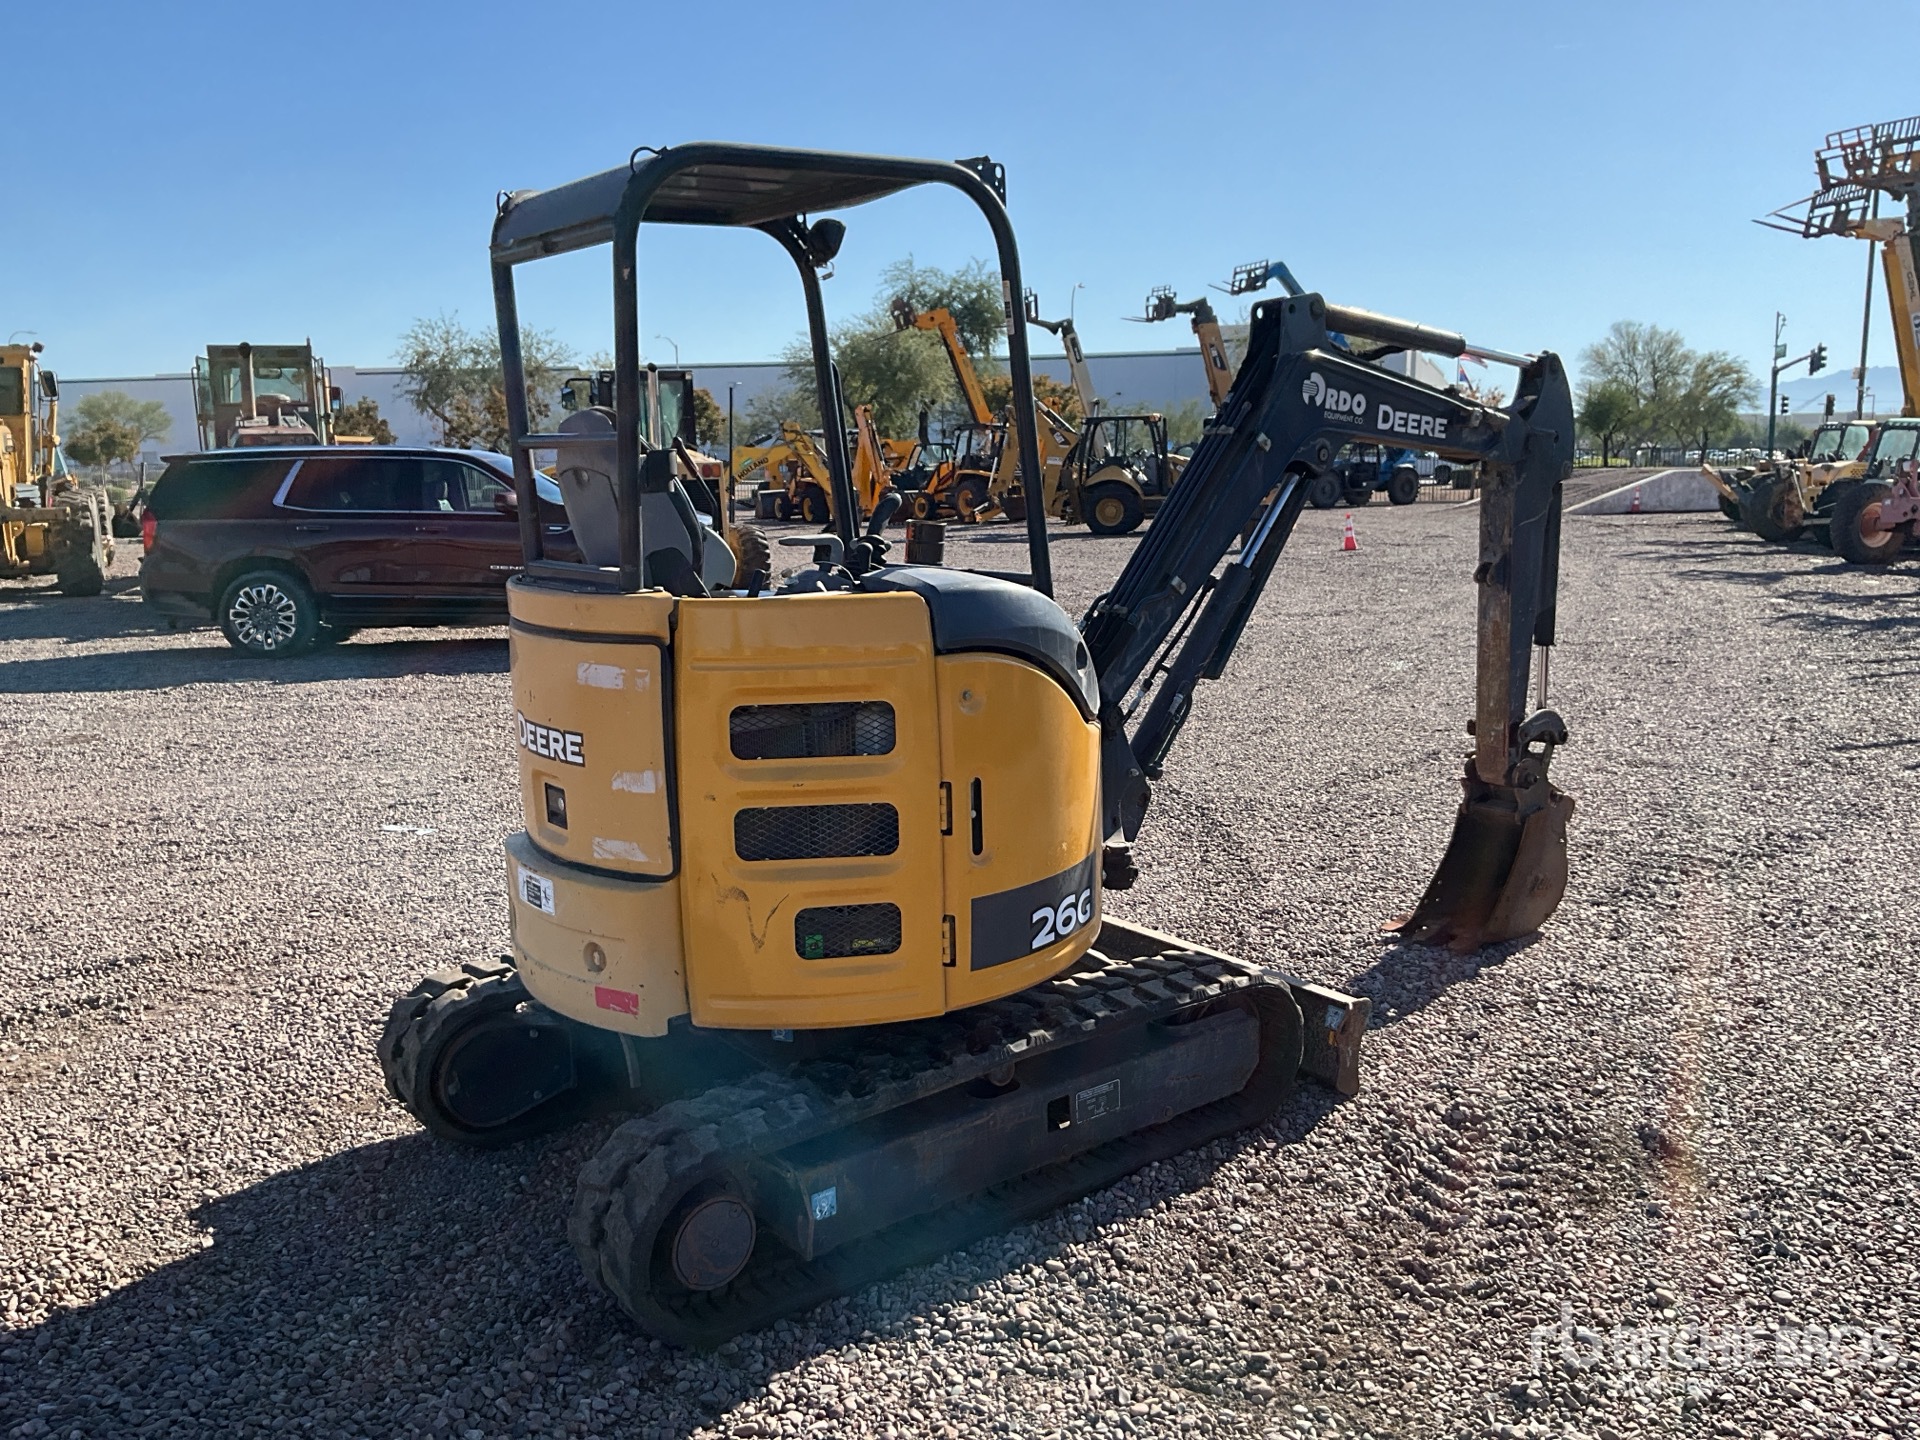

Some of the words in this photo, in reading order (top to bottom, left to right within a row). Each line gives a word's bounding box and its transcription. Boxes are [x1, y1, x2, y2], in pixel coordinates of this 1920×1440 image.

[1324, 411, 1354, 423] EQUIPMENT
[1377, 403, 1448, 439] DEERE
[737, 457, 770, 480] HOLLAND
[517, 710, 584, 765] DEERE
[1031, 888, 1091, 950] 26G
